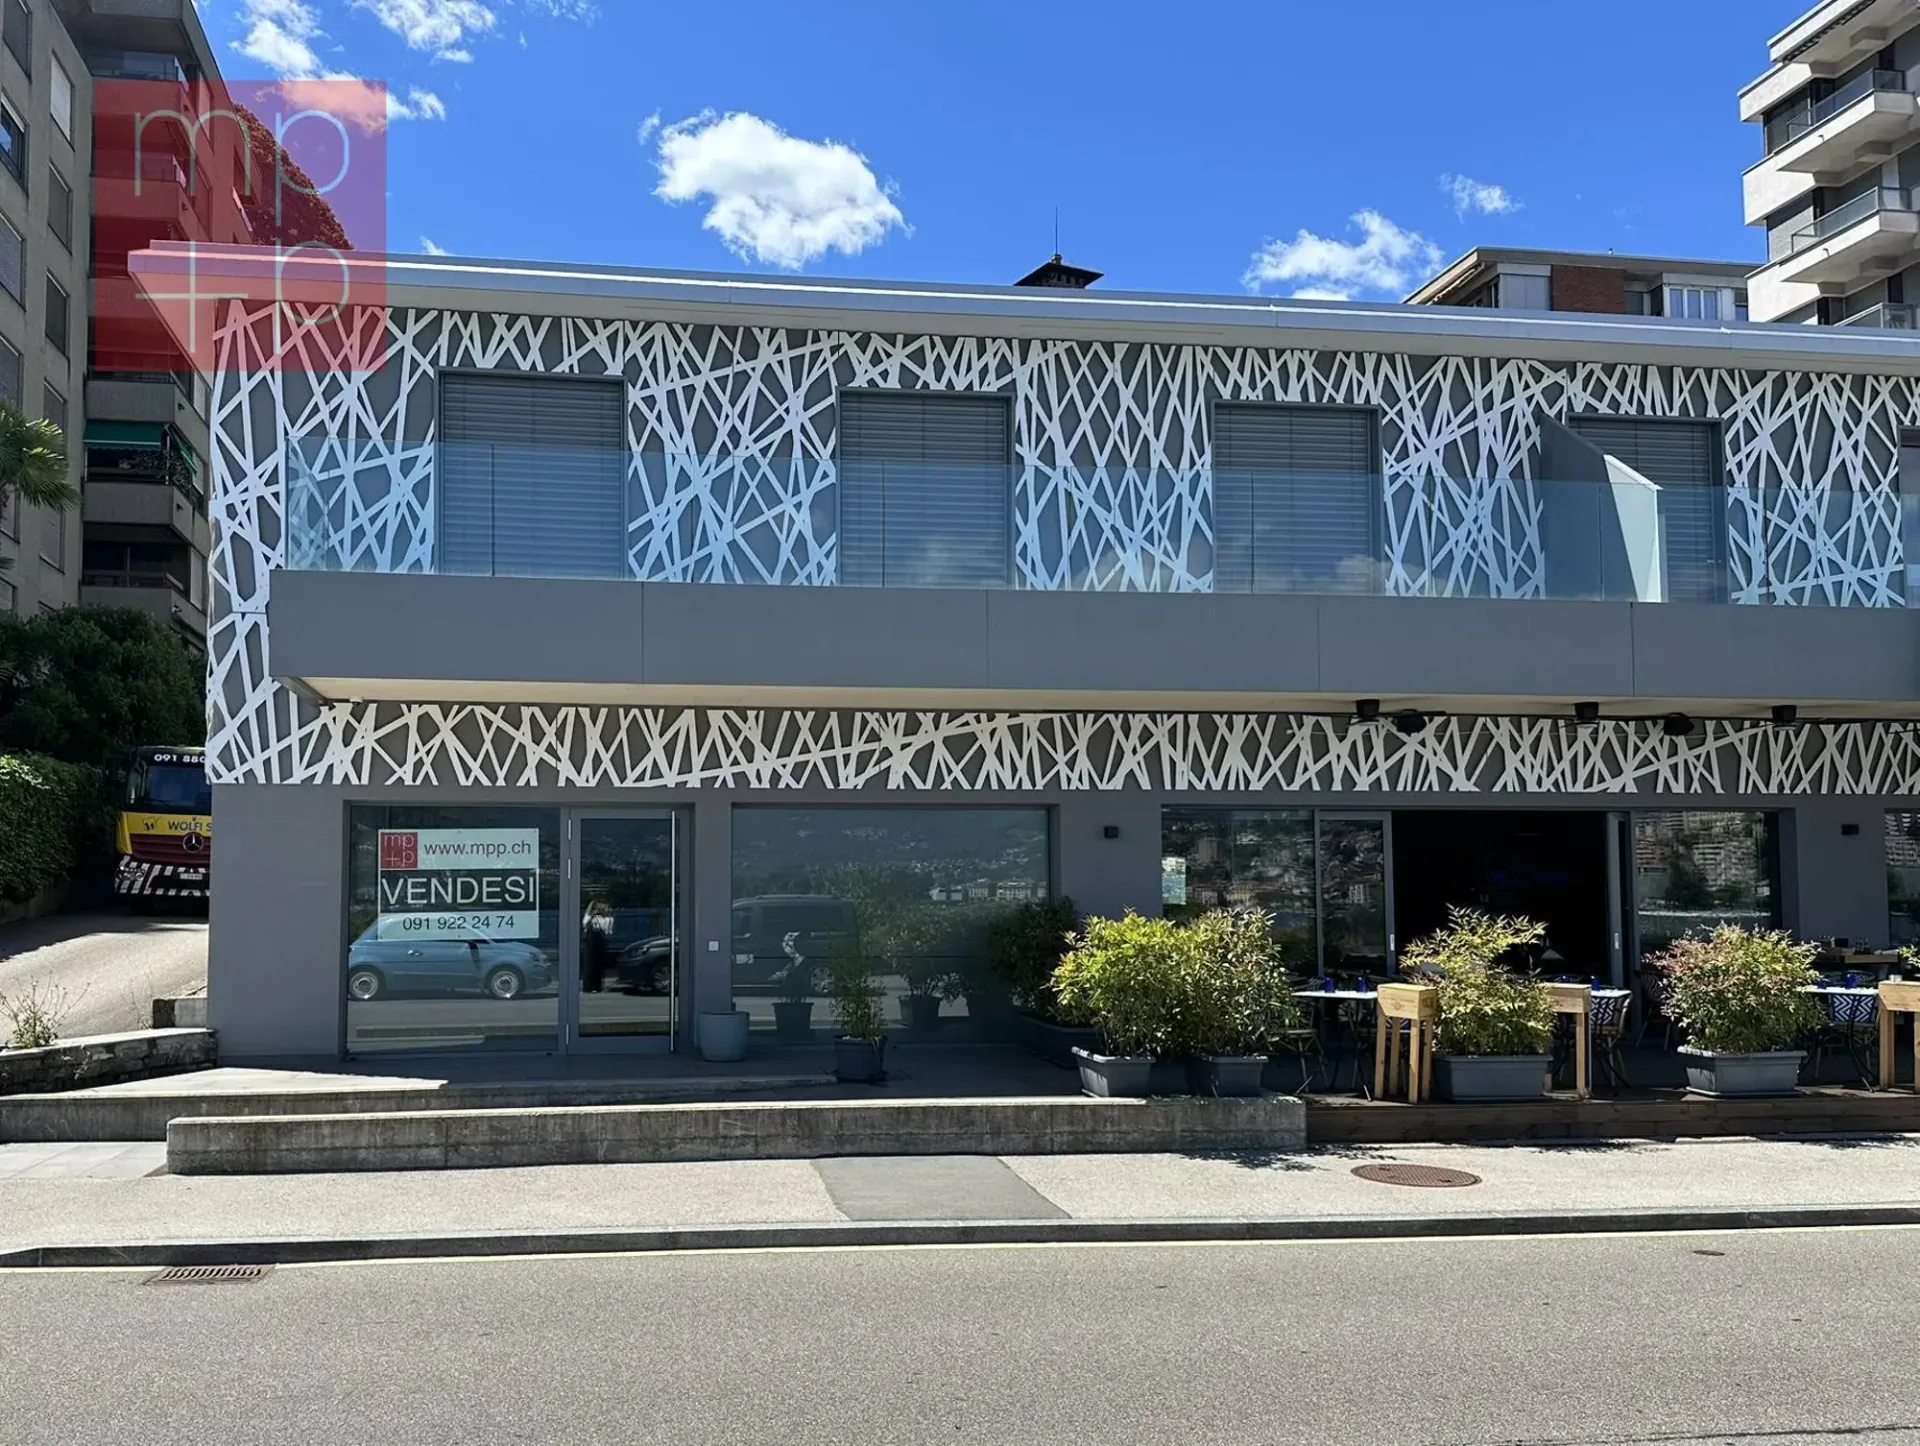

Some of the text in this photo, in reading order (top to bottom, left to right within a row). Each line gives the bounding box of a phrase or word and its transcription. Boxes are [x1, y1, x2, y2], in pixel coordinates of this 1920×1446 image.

[154, 753, 178, 762] 091
[424, 840, 531, 858] www.mpp.ch
[381, 876, 534, 905] VENDESI
[402, 915, 515, 931] 091 922 24 74
